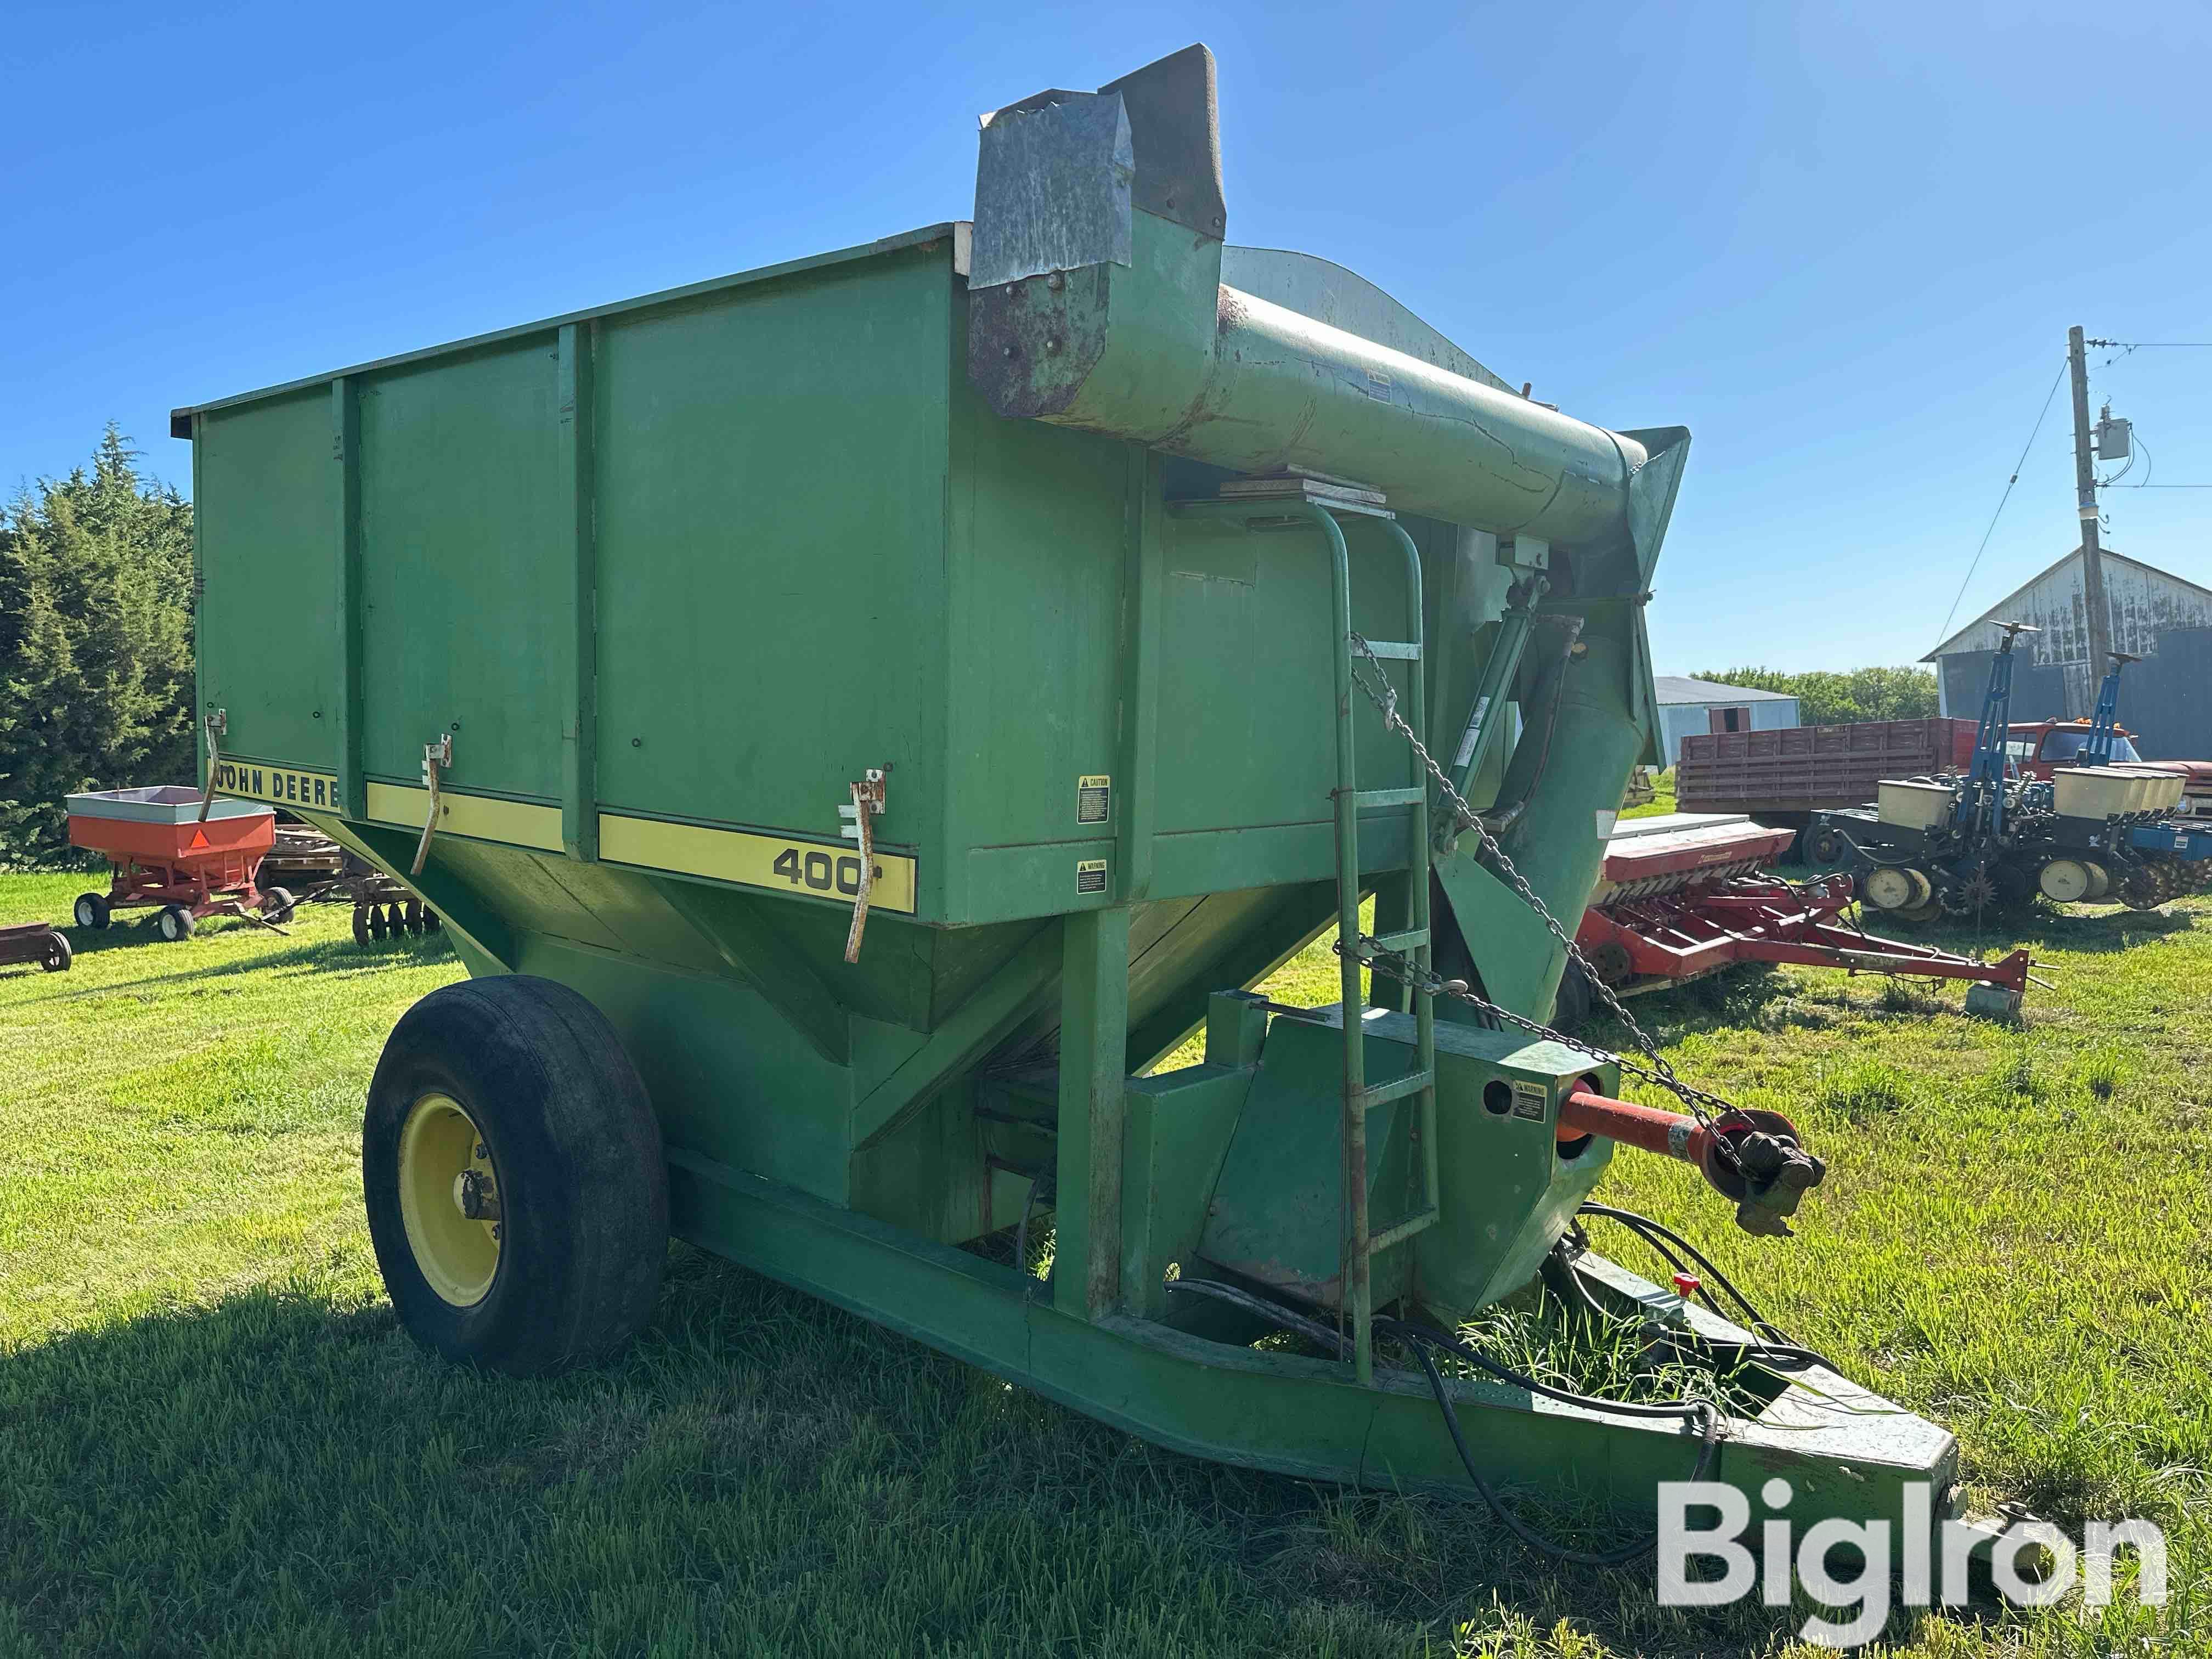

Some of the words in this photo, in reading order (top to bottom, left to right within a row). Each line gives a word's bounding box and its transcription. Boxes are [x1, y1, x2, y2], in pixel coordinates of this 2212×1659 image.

[217, 764, 262, 794] JOHN
[273, 772, 338, 807] DEERE
[1090, 778, 1108, 786] CAUTION
[1088, 861, 1105, 870] WARNING
[773, 848, 861, 896] 400
[1524, 1084, 1544, 1095] WARNING
